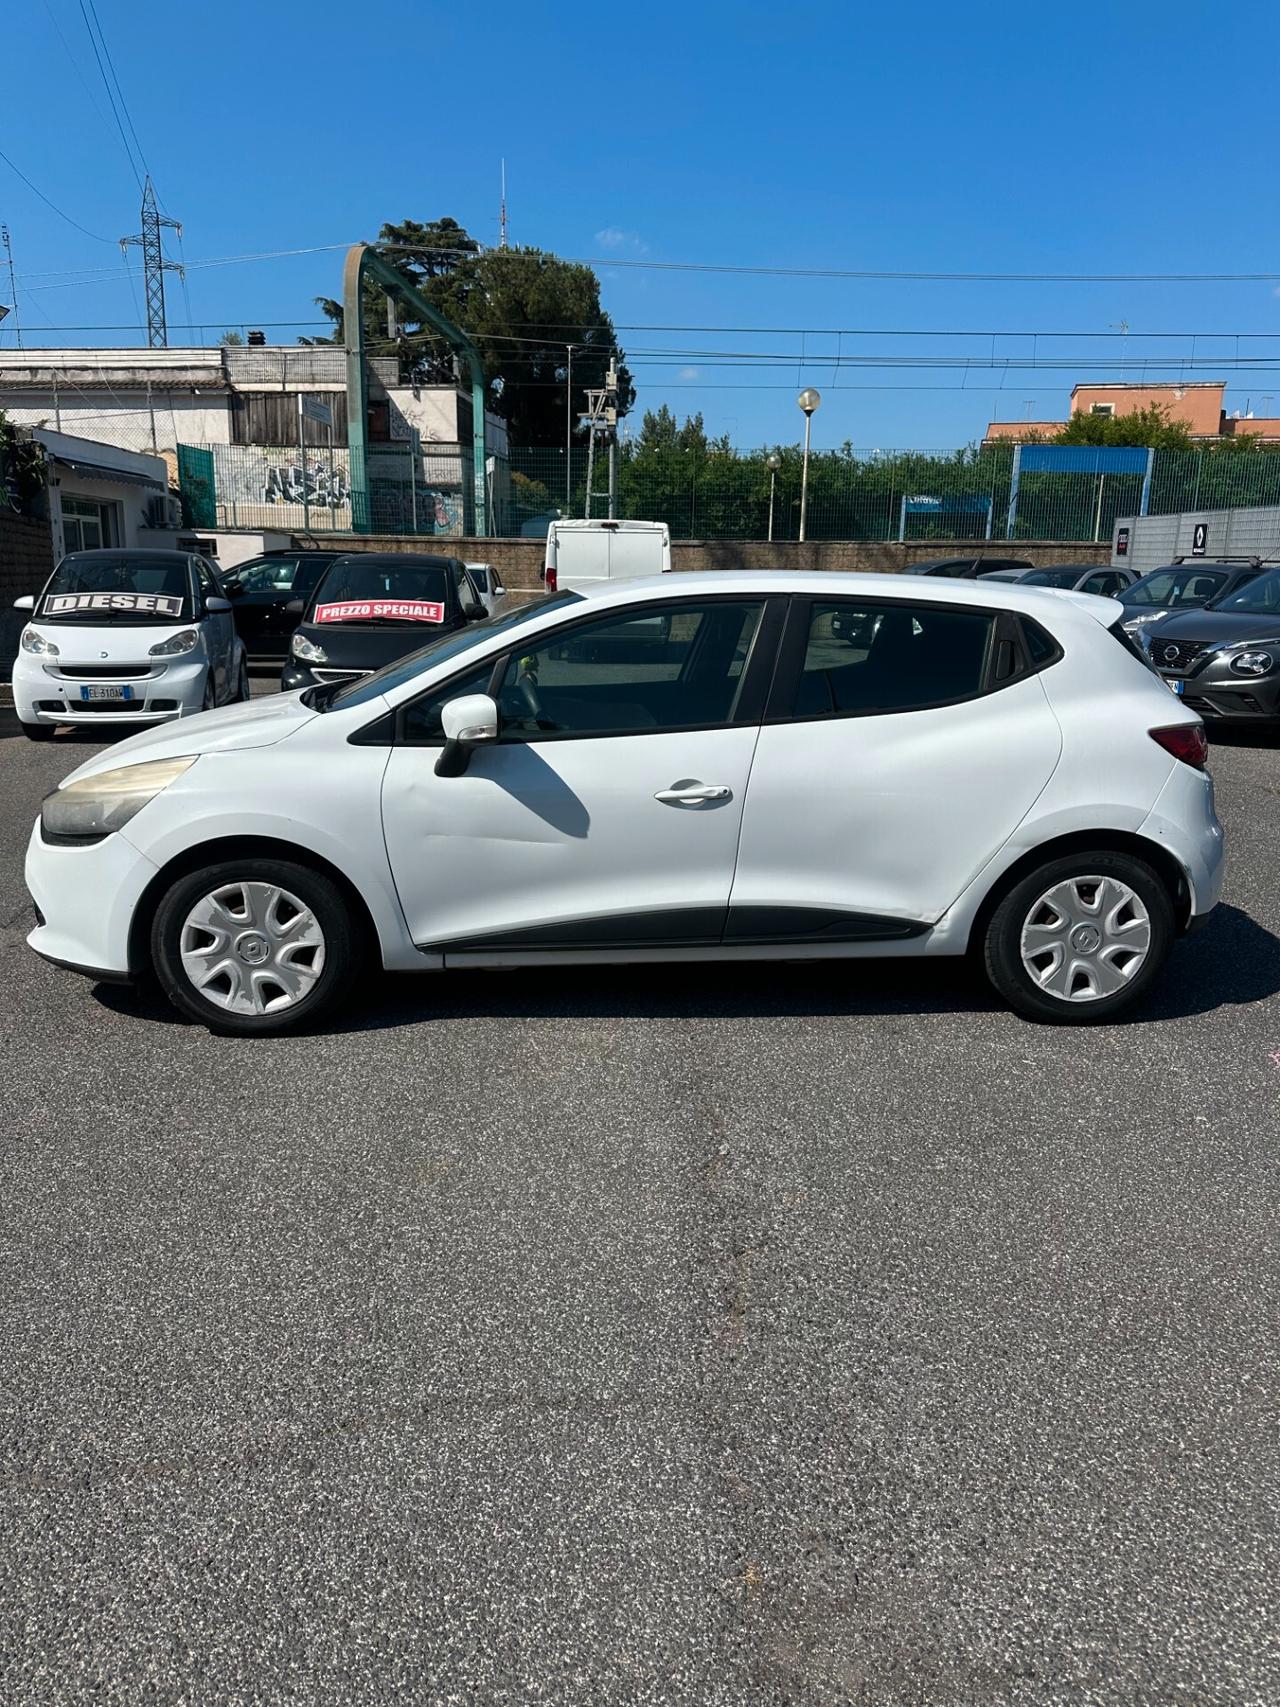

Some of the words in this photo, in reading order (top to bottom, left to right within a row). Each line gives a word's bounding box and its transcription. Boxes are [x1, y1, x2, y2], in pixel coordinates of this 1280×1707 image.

[52, 595, 174, 613] DIESEL
[322, 605, 371, 618] PREZZO
[373, 604, 438, 617] SPECIALE
